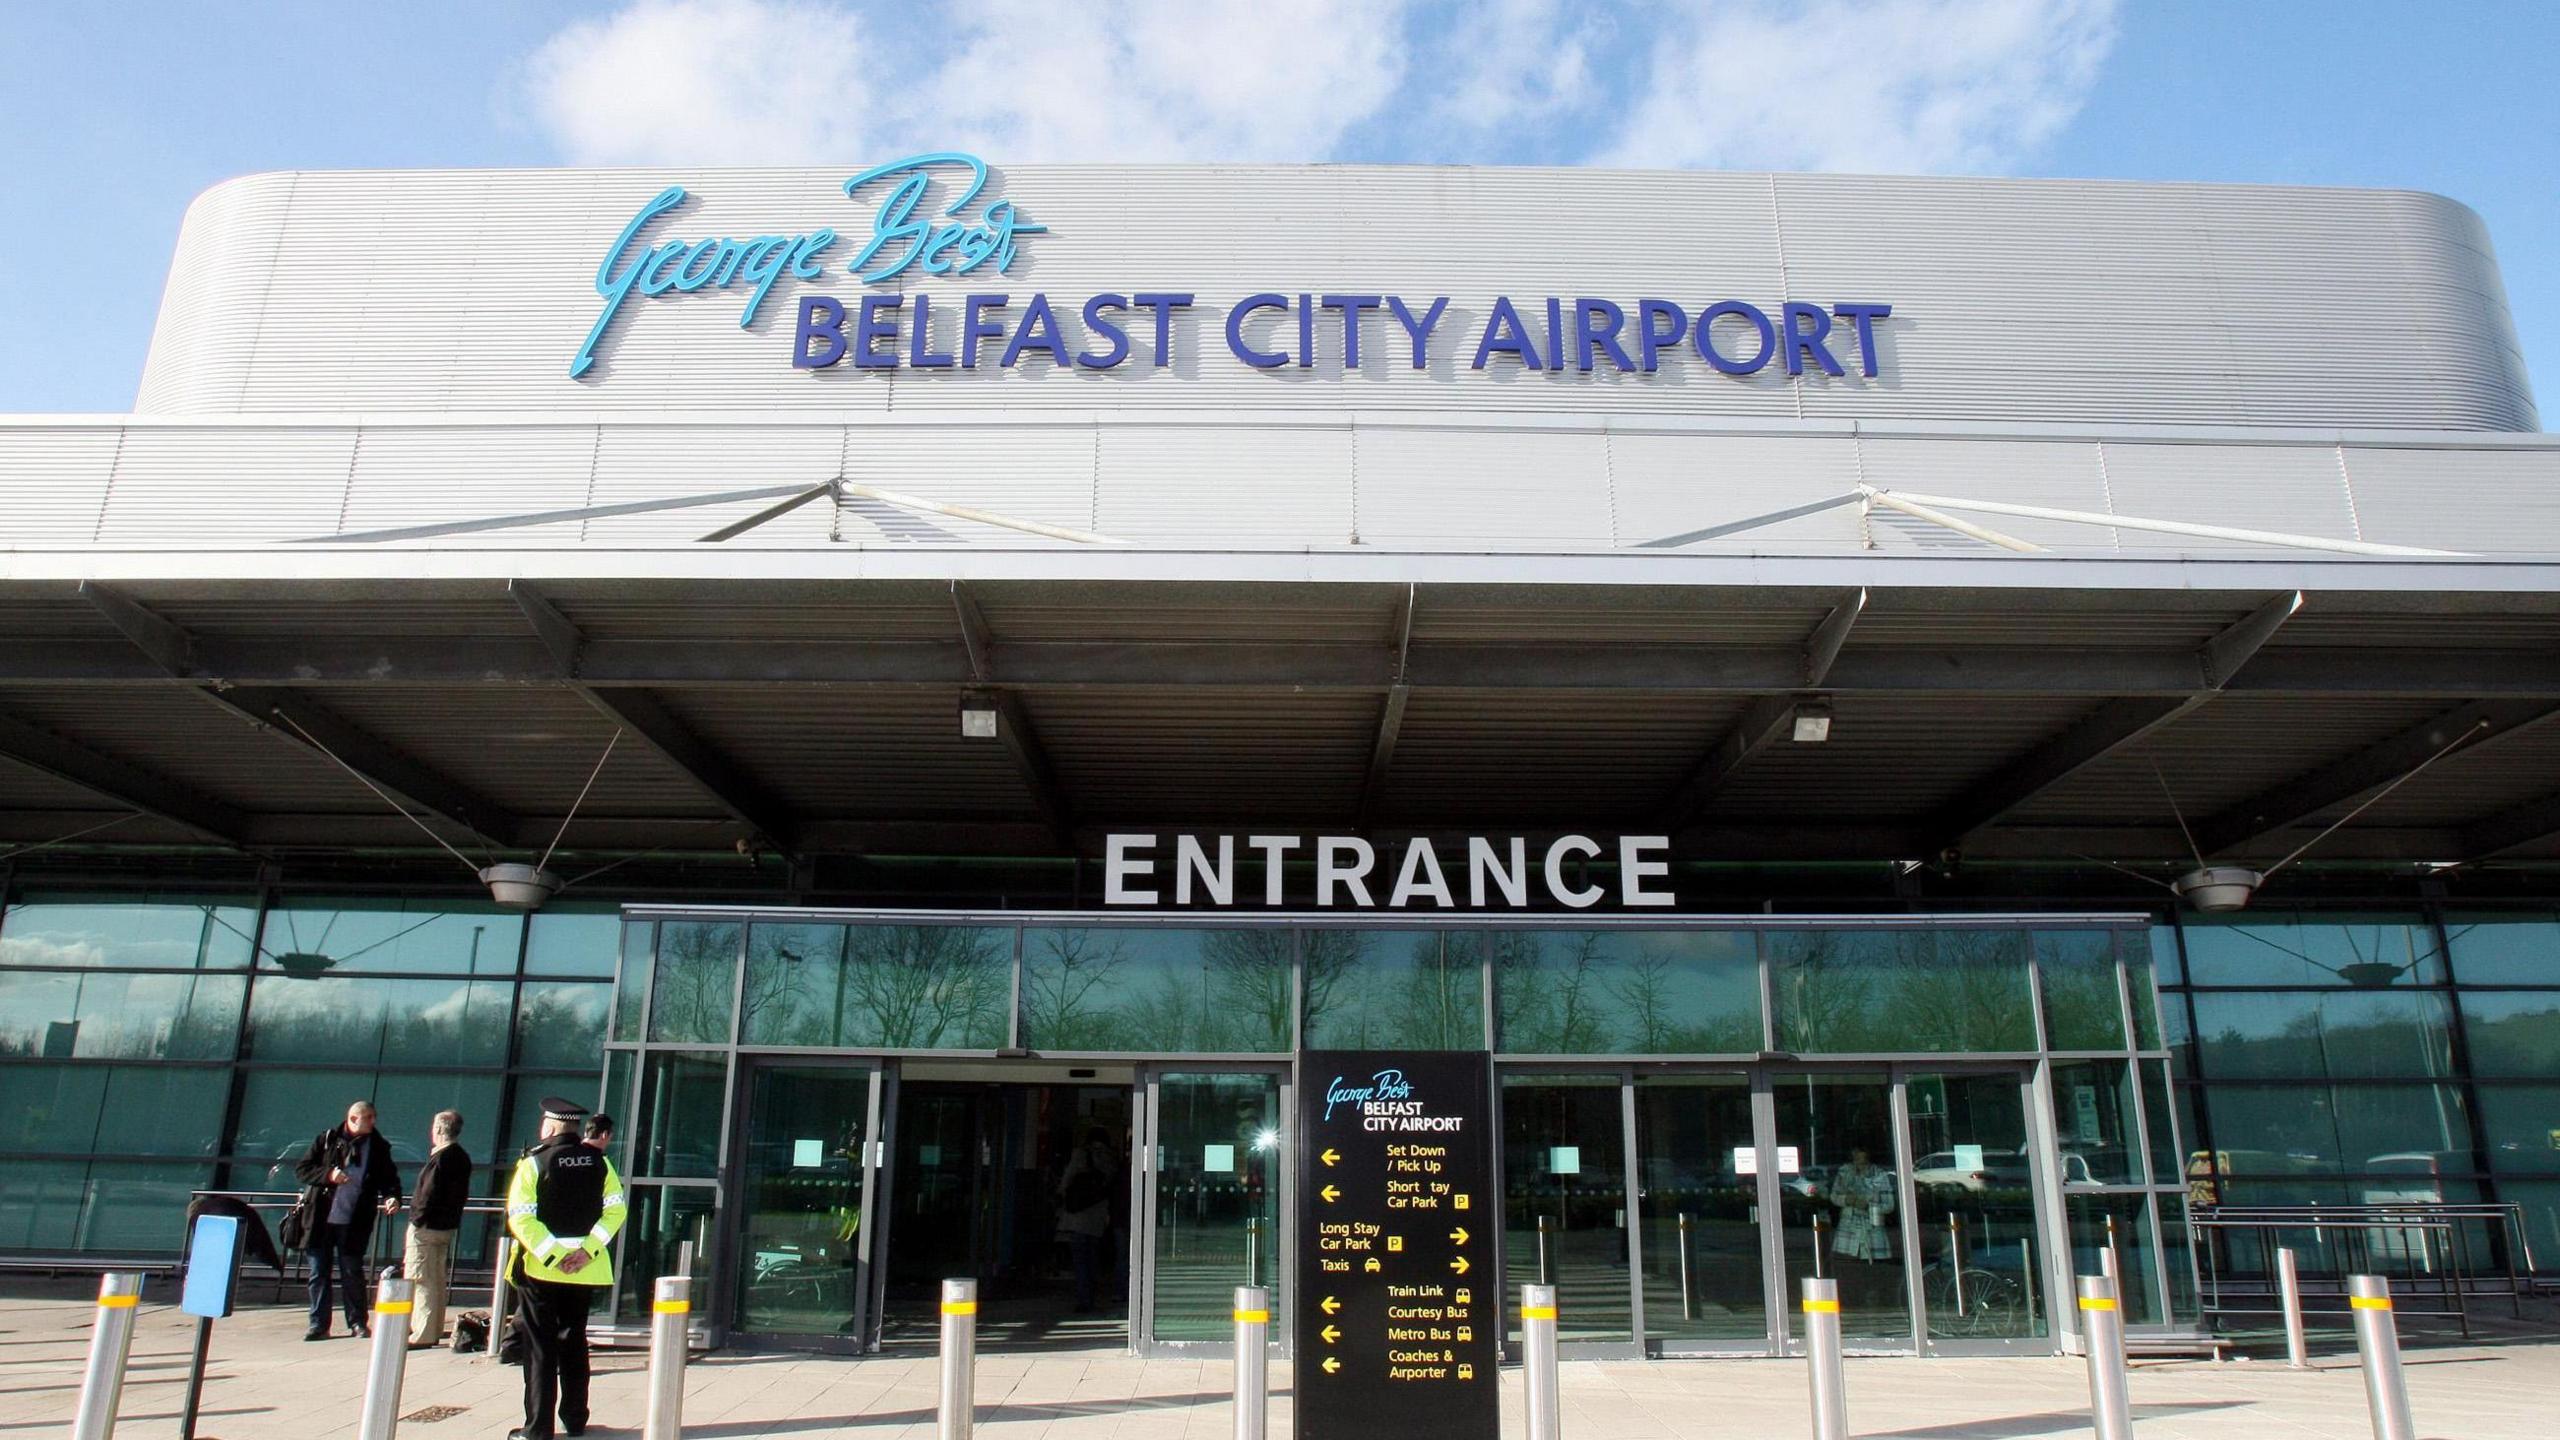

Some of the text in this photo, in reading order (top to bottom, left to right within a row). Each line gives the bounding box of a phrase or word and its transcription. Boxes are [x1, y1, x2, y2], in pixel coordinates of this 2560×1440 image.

[569, 152, 1048, 379] George Best
[792, 292, 1893, 377] BELFAST CITY AIRPORT
[1104, 833, 1676, 908] ENTRANCE
[1324, 1069, 1415, 1121] George Best
[1364, 1101, 1424, 1116] BELFAST
[1363, 1117, 1463, 1132] CITY AIRPORT
[1387, 1144, 1446, 1157] Set Down
[558, 1156, 593, 1167] POLICE
[1397, 1160, 1421, 1172] Pick
[1424, 1160, 1441, 1174] Up
[1387, 1180, 1420, 1193] Short
[1387, 1196, 1408, 1208] Car
[1412, 1196, 1438, 1208] Park
[1320, 1222, 1380, 1237] Long Stay
[1320, 1238, 1341, 1250] Car
[1345, 1237, 1371, 1250] Park
[1320, 1259, 1350, 1271] Taxis
[1387, 1284, 1444, 1297] Train Link
[1388, 1306, 1468, 1320] Courtesy Bus
[1388, 1327, 1452, 1340] Metro Bus
[1388, 1349, 1454, 1362] Coaches &
[1389, 1366, 1447, 1381] Airporter
